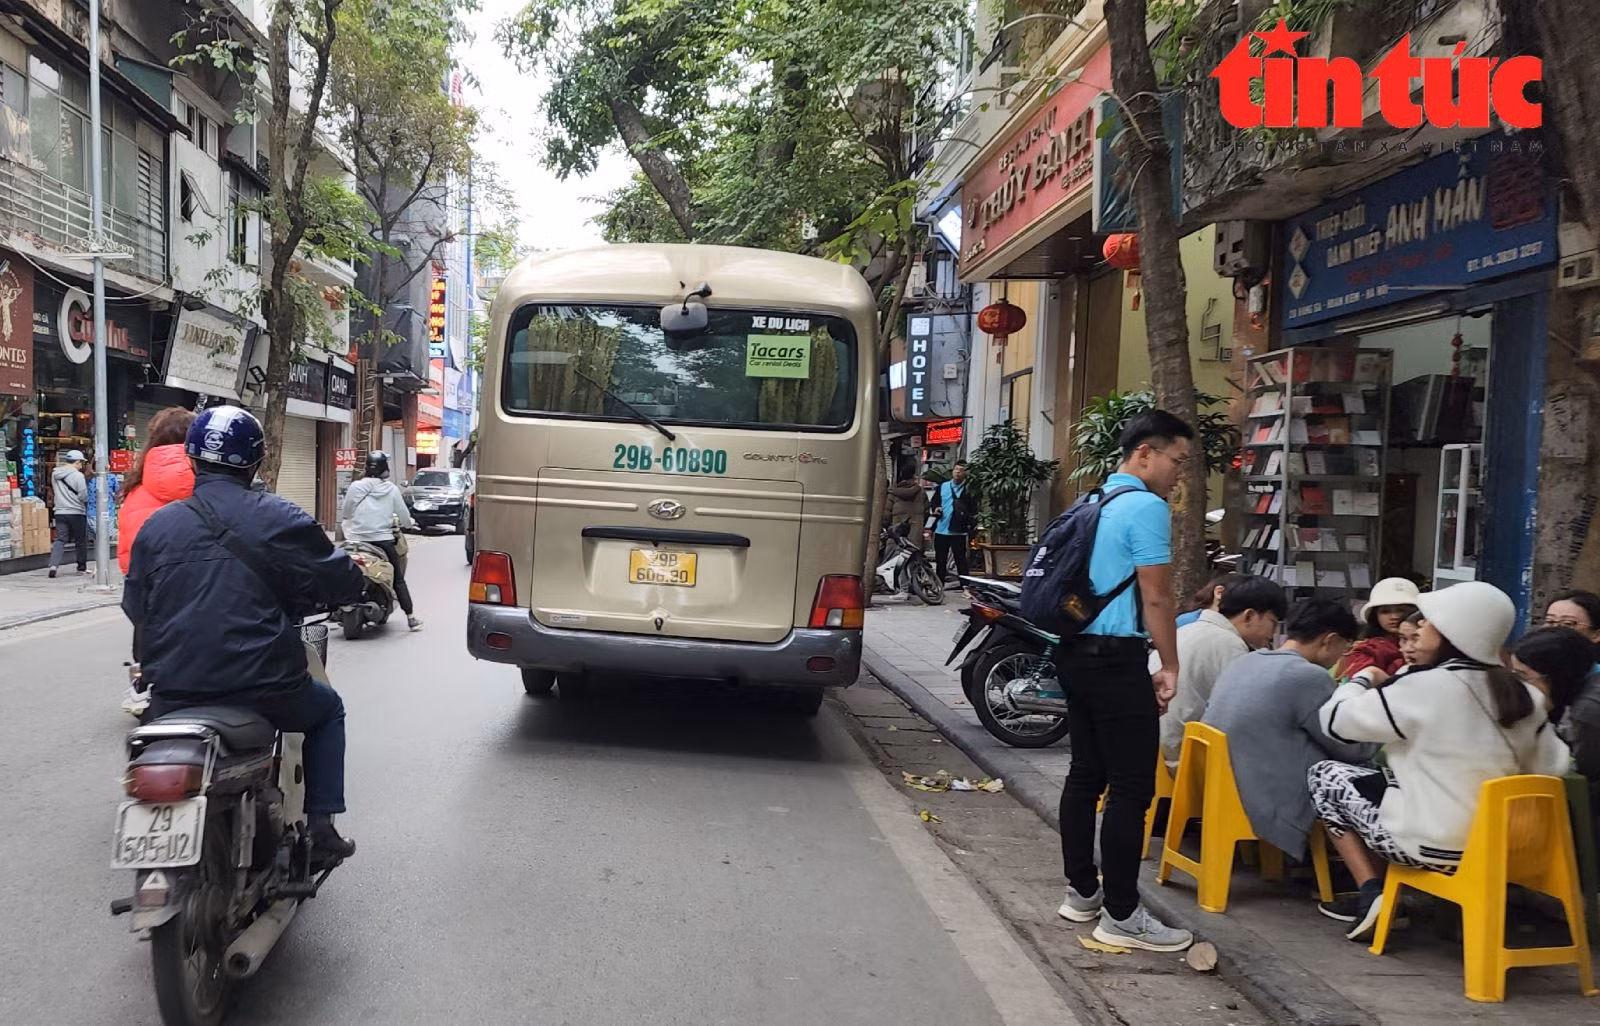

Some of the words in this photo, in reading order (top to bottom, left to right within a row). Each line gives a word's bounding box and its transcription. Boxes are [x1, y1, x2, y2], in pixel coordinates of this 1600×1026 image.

[1032, 106, 1094, 191] BÌNH
[1385, 194, 1429, 251] ANH
[752, 316, 767, 328] XE
[768, 317, 784, 329] DU
[785, 318, 810, 333] LỊCH
[751, 343, 804, 358] Tacars
[331, 374, 348, 396] OANH
[912, 339, 927, 416] HOTEL
[336, 450, 357, 461] SAL
[613, 443, 727, 475] 29B-60890
[149, 805, 174, 833] 29
